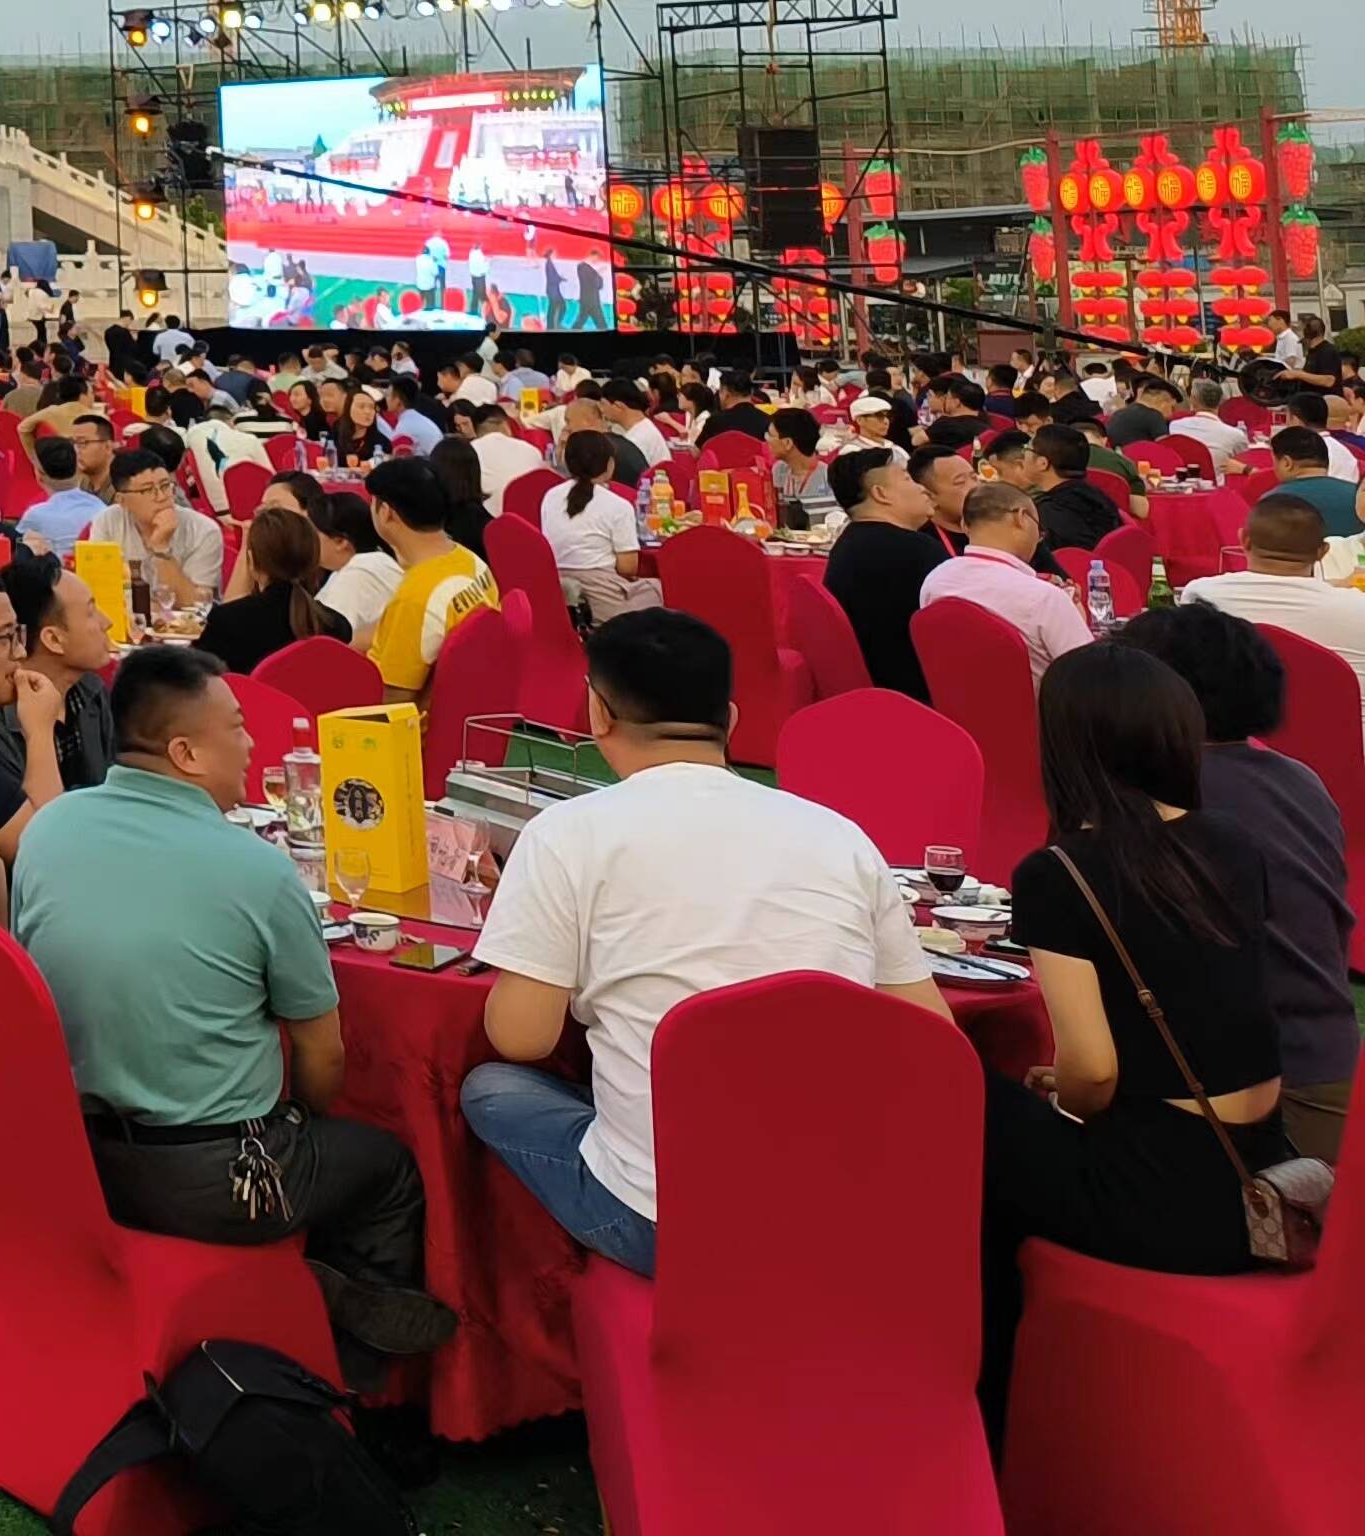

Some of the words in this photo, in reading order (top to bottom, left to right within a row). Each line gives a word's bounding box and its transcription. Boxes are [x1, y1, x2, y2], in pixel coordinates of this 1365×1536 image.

[1092, 180, 1110, 204] 福
[1160, 175, 1181, 205] 福
[1231, 168, 1250, 199] 福
[613, 192, 636, 215] 福
